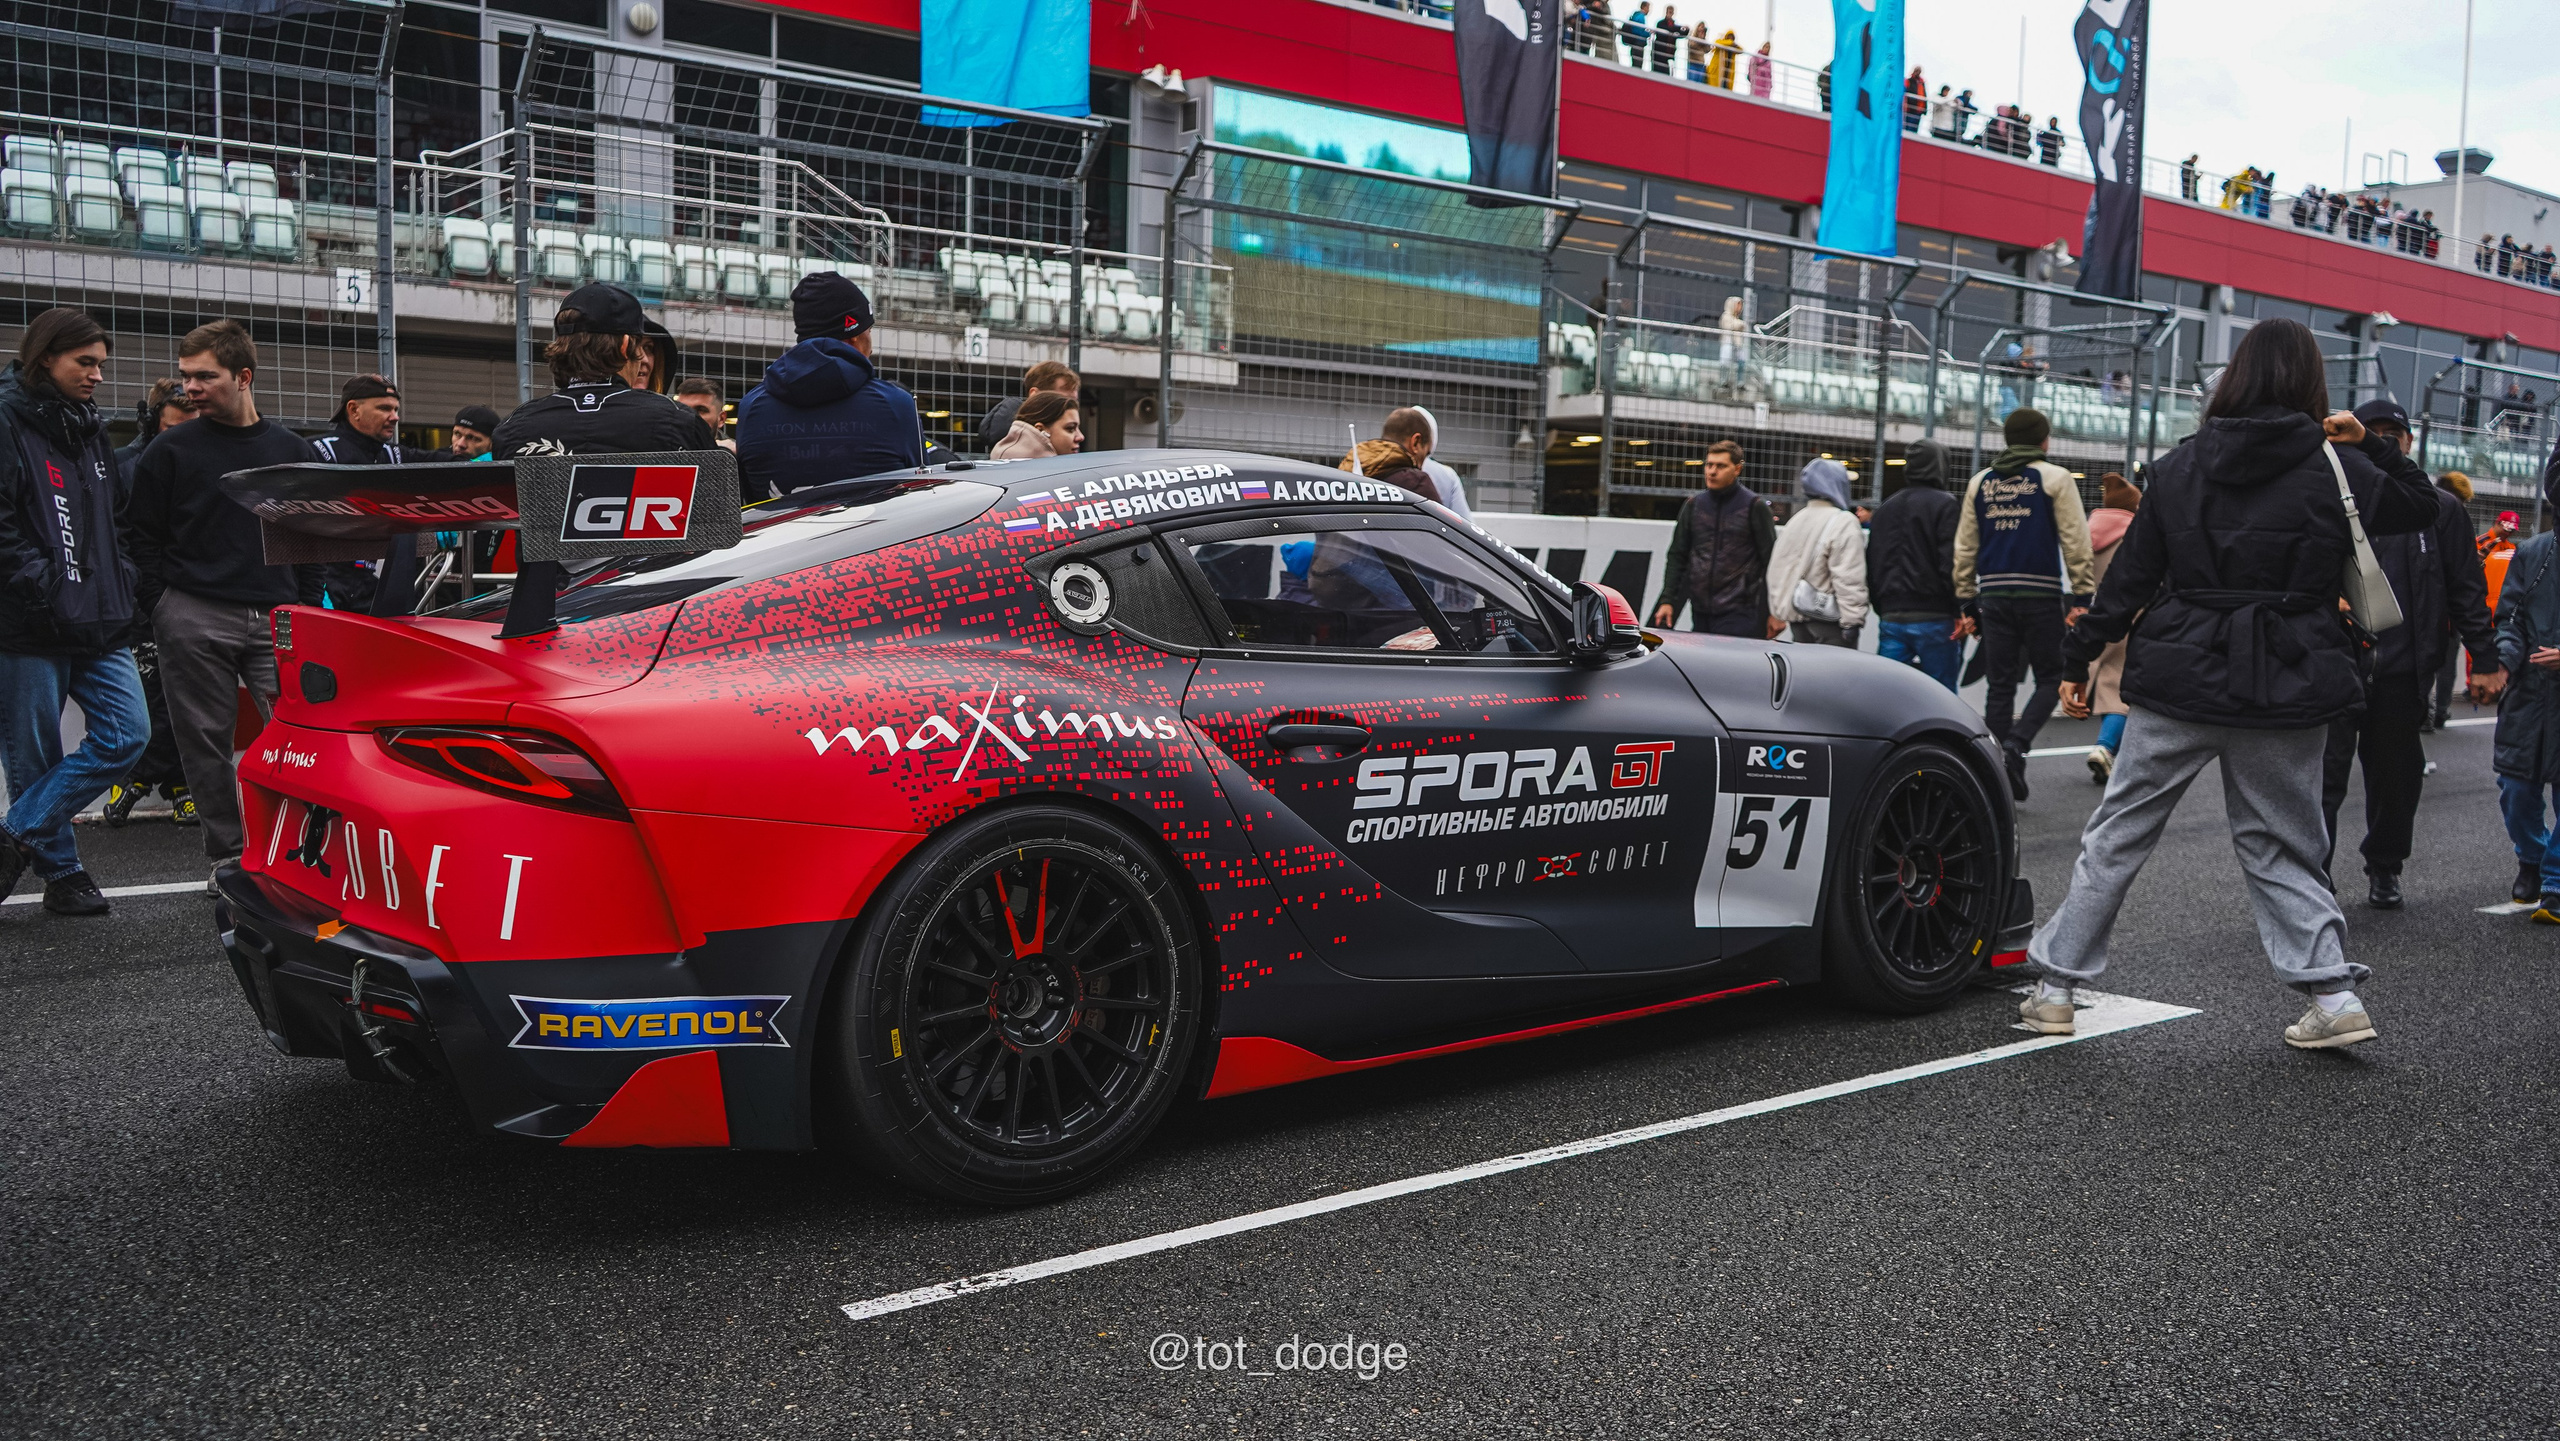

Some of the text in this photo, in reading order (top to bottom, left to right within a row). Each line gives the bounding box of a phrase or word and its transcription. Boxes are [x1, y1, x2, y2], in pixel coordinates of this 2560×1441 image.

[347, 275, 361, 303] 5
[971, 333, 983, 357] 6
[1981, 475, 2038, 495] Wrangler
[46, 460, 82, 583] SPORA GT
[573, 496, 686, 532] GR
[804, 680, 1177, 783] maximus
[1353, 740, 1675, 810] SPORA GT
[1346, 793, 1668, 844] СПОРТИВНЫЕ АВТОМОБИЛИ
[1726, 796, 1812, 871] 51
[1436, 841, 1669, 896] НЕФРО СОВЕТ
